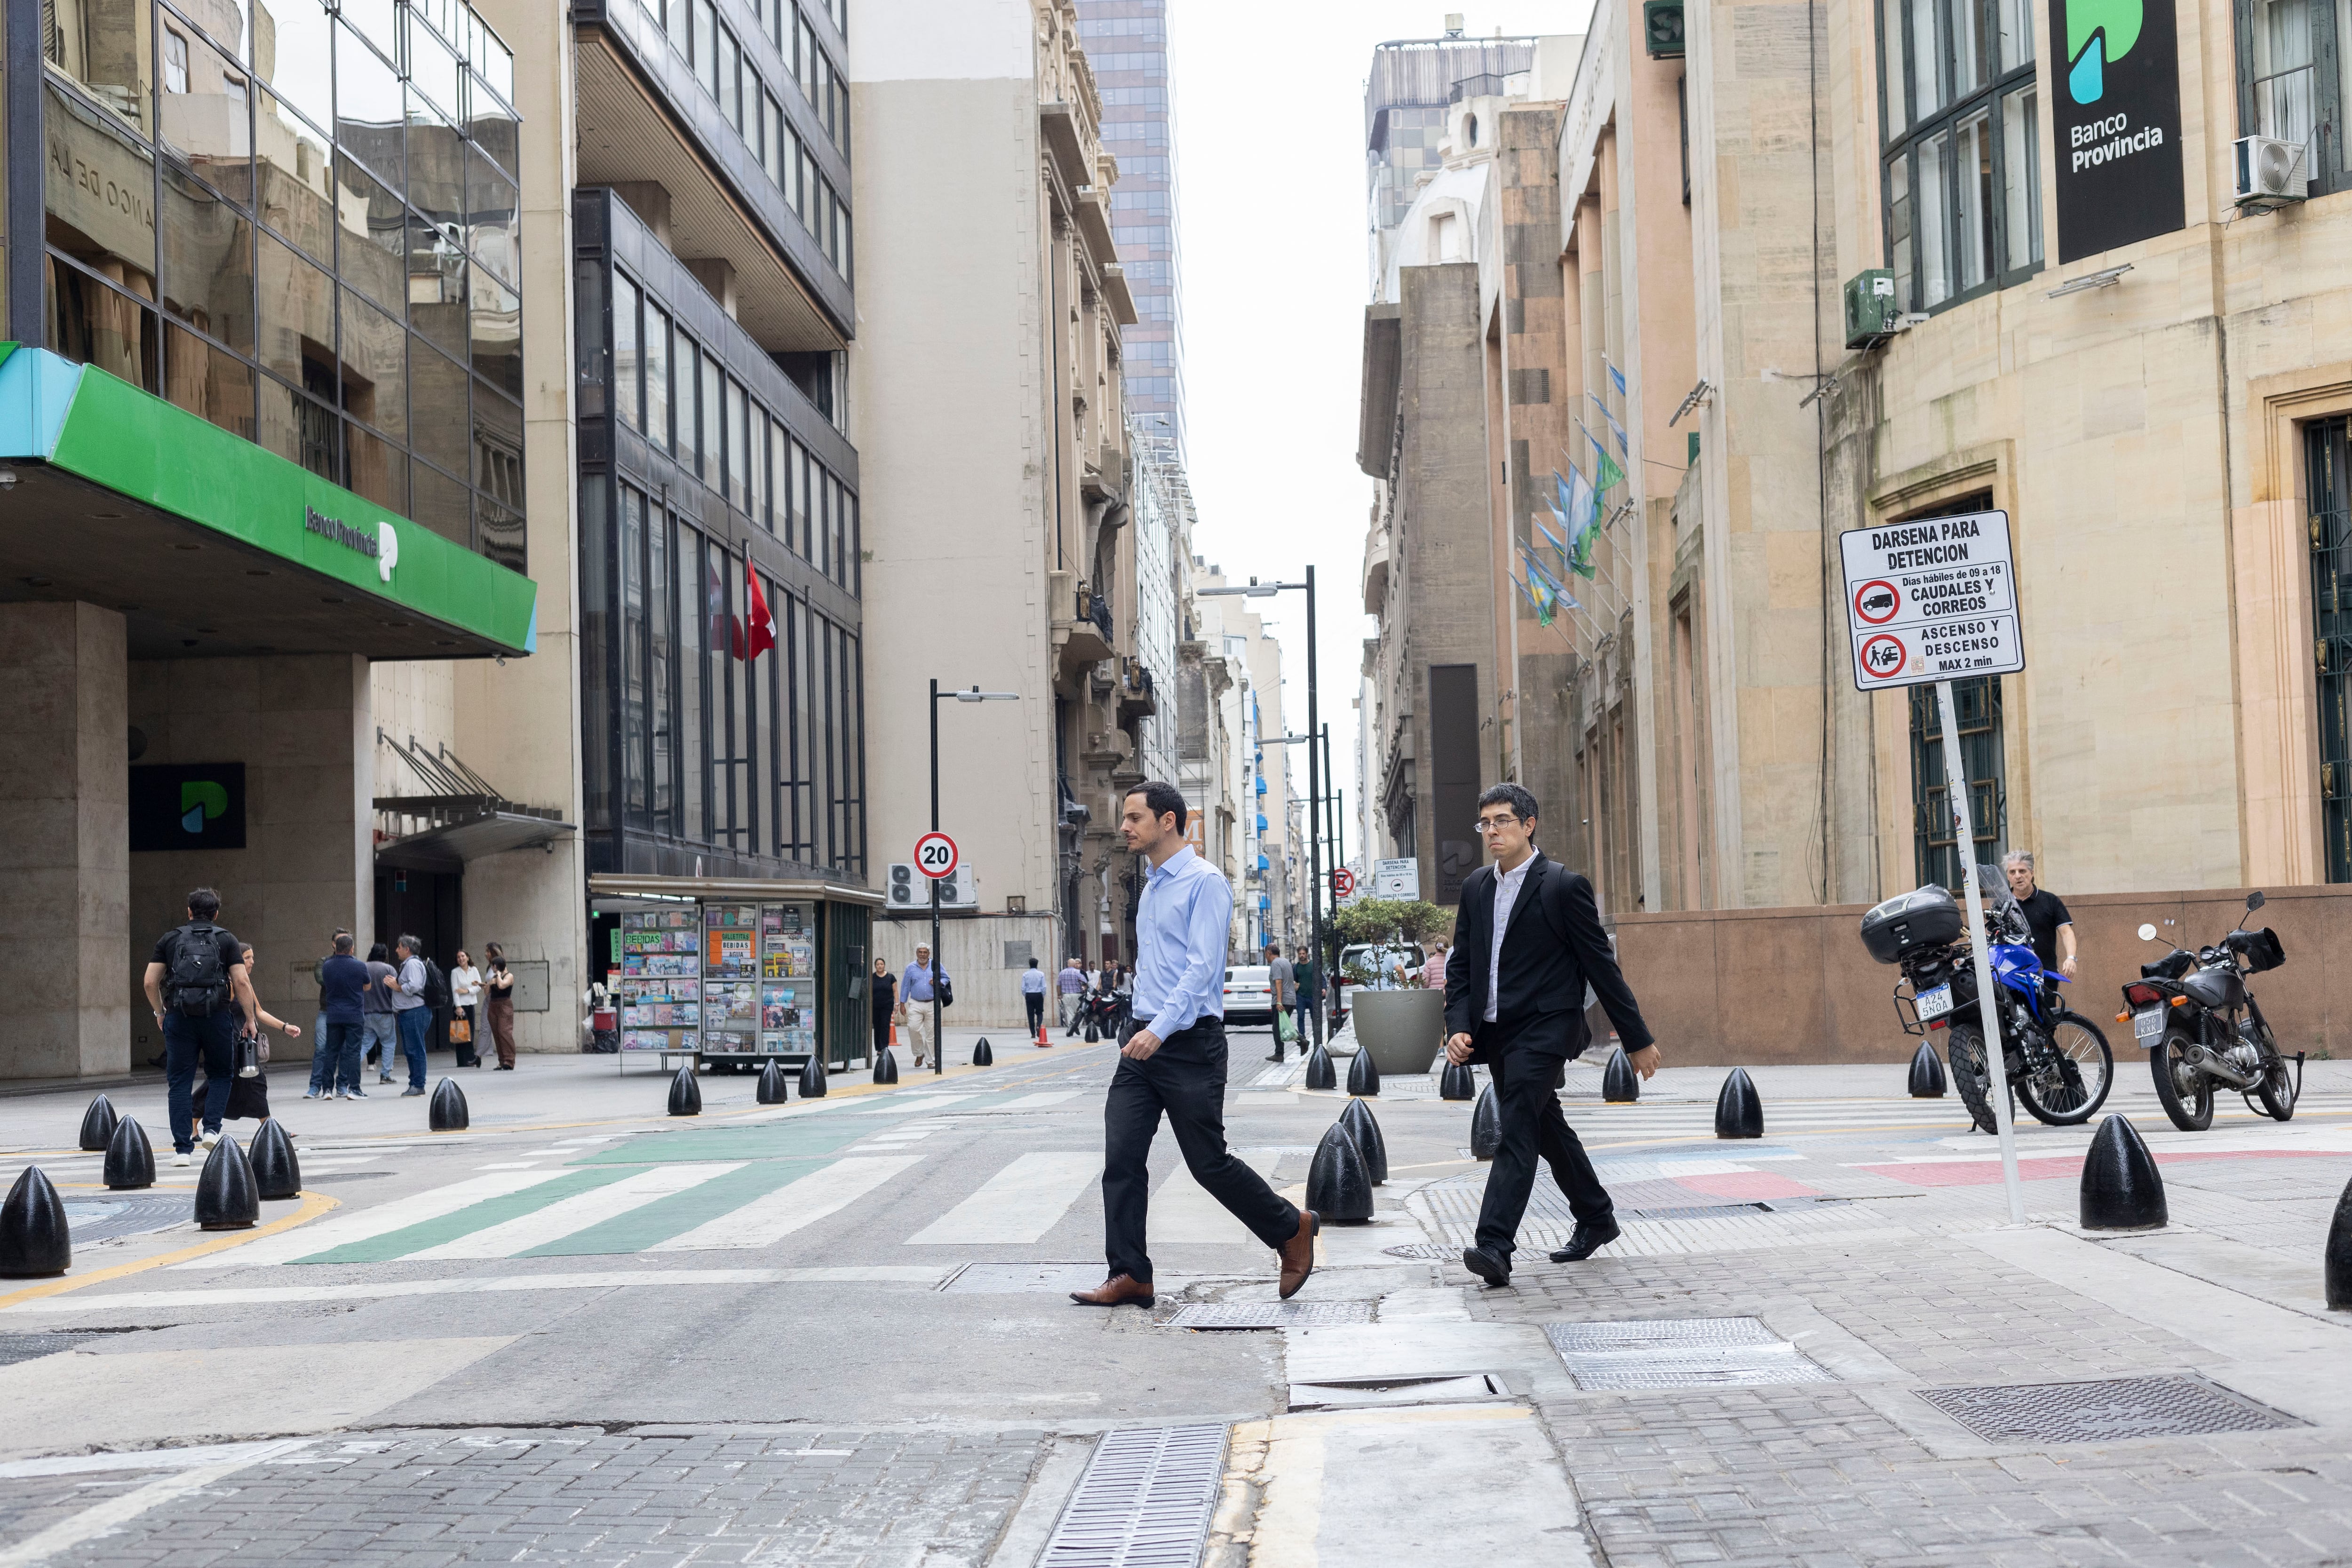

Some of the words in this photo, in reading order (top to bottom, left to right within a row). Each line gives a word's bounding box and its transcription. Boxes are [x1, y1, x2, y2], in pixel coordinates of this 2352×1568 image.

[2071, 112, 2127, 148] Banco
[2072, 126, 2163, 173] Provincia
[306, 504, 335, 539] Banco
[335, 518, 377, 557] Provincia
[1872, 525, 1938, 550] DARSENA
[1941, 520, 1980, 541] PARA
[1888, 543, 1969, 570] DETENCION
[1902, 577, 1921, 587] Días
[1923, 573, 1954, 584] hábiles
[1956, 571, 1967, 579] de
[1969, 568, 1980, 577] 09
[1990, 565, 2001, 574] 18
[1911, 580, 1981, 602] CAUDALES
[1985, 578, 1994, 593] Y
[1923, 596, 1986, 616] CORREOS
[1921, 621, 1986, 641] ASCENSO
[1990, 620, 1999, 631] Y
[1925, 637, 1999, 657] DESCENSO
[1939, 658, 1962, 671] MAX
[1964, 658, 1972, 669] 2
[1973, 656, 1992, 667] min
[923, 846, 949, 864] 20
[625, 935, 660, 944] BEBIDAS
[1925, 992, 1943, 1006] A24
[2141, 1024, 2156, 1035] KXK
